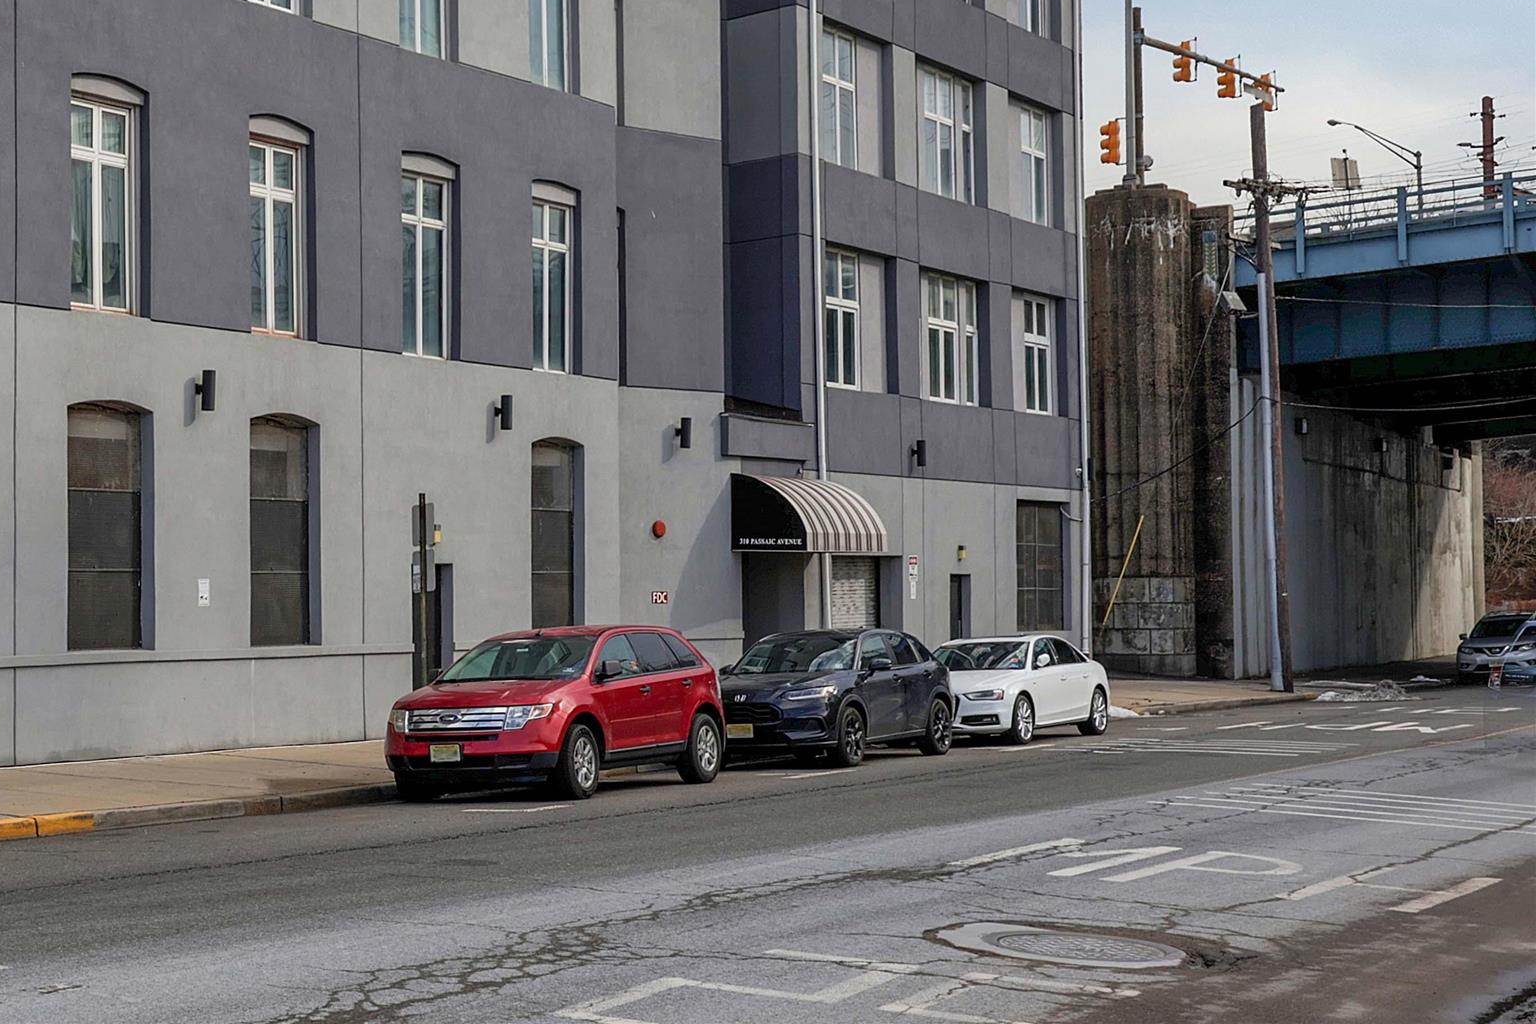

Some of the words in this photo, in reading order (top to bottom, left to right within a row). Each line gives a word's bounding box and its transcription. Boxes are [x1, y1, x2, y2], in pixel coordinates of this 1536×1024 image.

[750, 537, 776, 545] PASSAIC
[652, 591, 667, 604] FDC
[948, 836, 1504, 914] MPH
